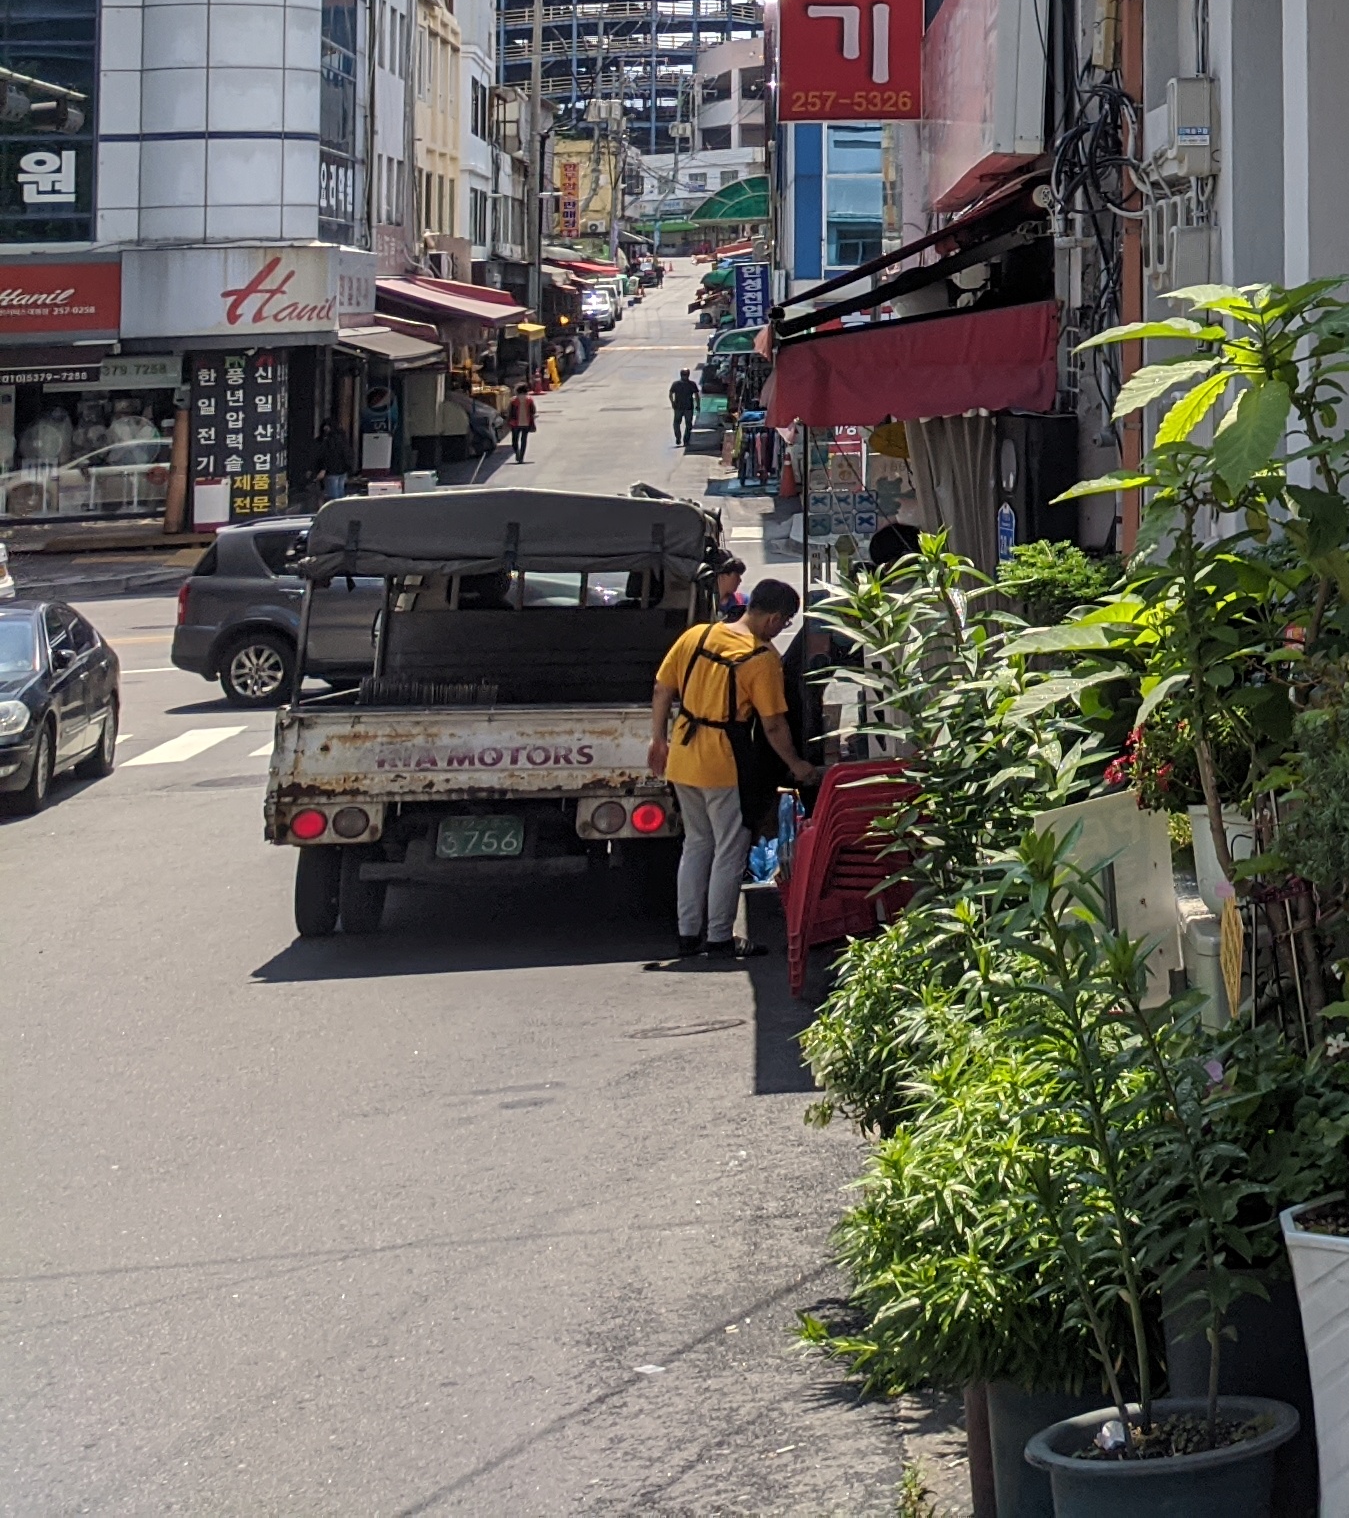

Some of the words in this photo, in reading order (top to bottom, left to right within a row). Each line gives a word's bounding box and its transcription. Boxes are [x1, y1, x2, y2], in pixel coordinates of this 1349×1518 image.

[791, 90, 913, 113] 257-5326
[17, 150, 76, 203] 원
[221, 257, 338, 326] Hanil
[196, 368, 217, 473] 한일전기
[253, 366, 274, 470] 신일산업
[233, 473, 271, 491] 제품
[232, 495, 271, 513] 전문
[446, 744, 595, 768] MOTORS
